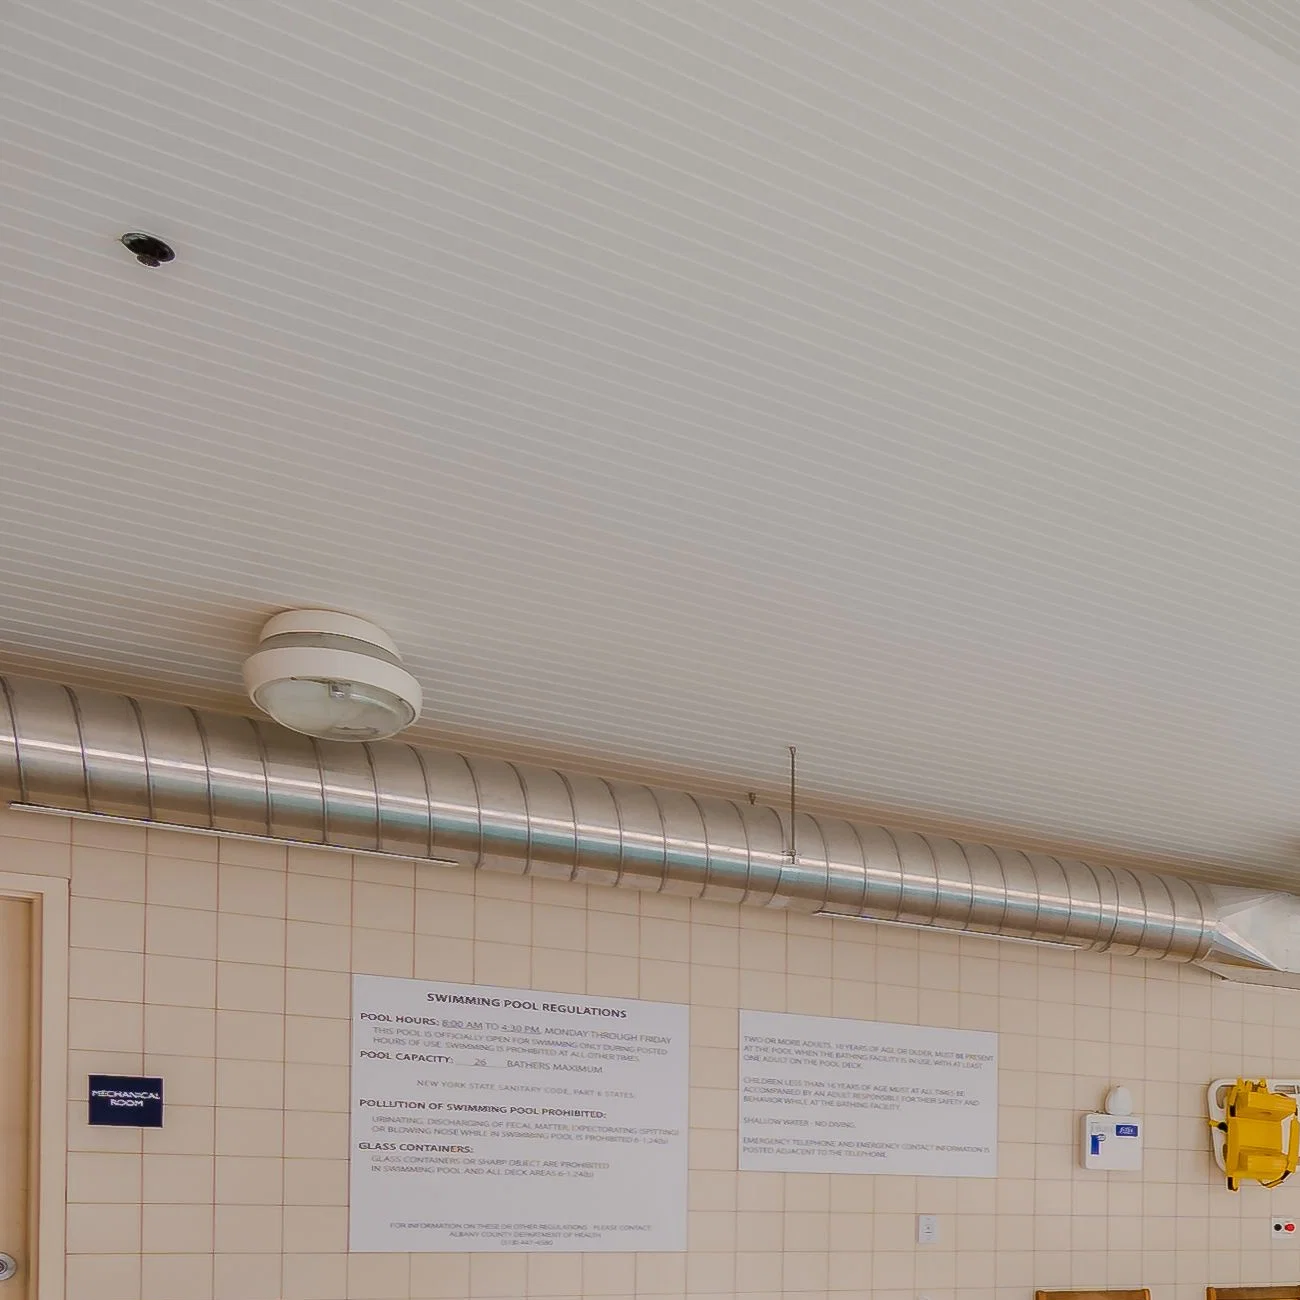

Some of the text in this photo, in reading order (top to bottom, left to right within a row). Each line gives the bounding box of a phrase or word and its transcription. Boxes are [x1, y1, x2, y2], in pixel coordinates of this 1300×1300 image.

[426, 992, 627, 1018] SWIMMING POOL REGULATIONS
[359, 1011, 391, 1022] POOL
[394, 1014, 439, 1026] HOURS:
[466, 1020, 482, 1029] AM
[485, 1021, 498, 1030] TO
[544, 1026, 588, 1037] MONDAY
[591, 1030, 638, 1041] THROUGH
[639, 1033, 672, 1044] FRIDAY
[373, 1026, 393, 1035] THIS
[395, 1028, 422, 1037] POOL
[408, 1038, 420, 1046] OF
[359, 1050, 392, 1060] POOL
[395, 1052, 454, 1064] CAPACITY:
[506, 1059, 550, 1070] BATHERS
[552, 1062, 602, 1073] MAXIMUM
[416, 1078, 439, 1088] NEW
[91, 1090, 161, 1099] MECHANICAL
[110, 1099, 144, 1107] ROOM
[359, 1098, 607, 1118] POLLUTION OF SWIMMING POOL PROHIBITED:
[358, 1141, 474, 1153] GLASS CONTAINERS:
